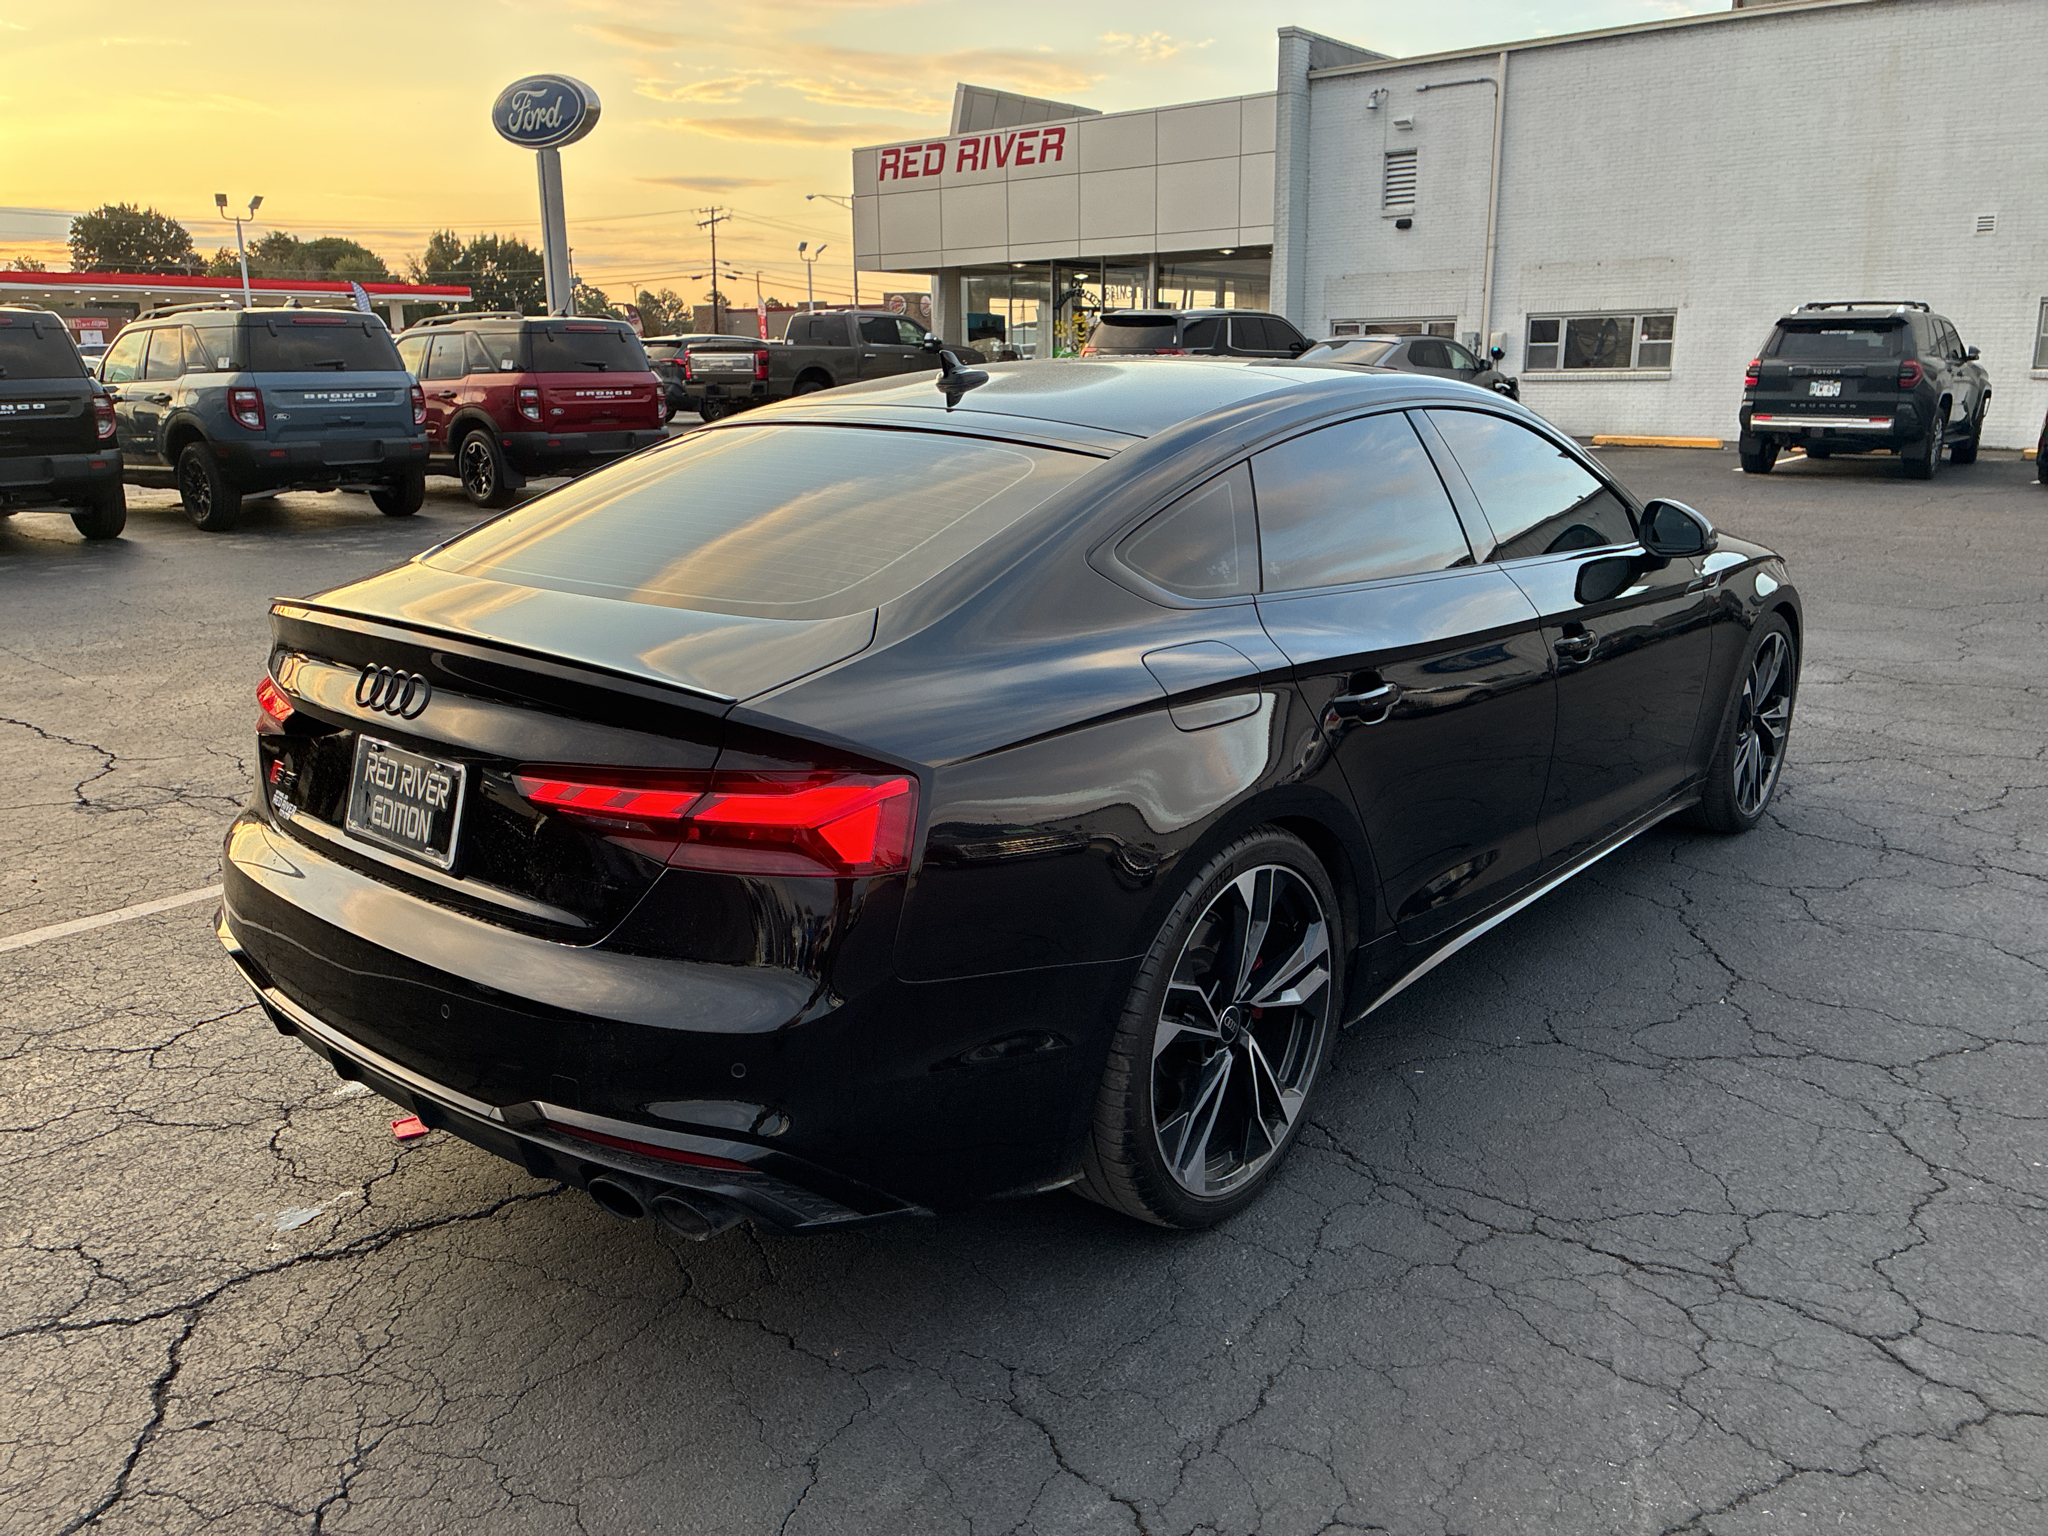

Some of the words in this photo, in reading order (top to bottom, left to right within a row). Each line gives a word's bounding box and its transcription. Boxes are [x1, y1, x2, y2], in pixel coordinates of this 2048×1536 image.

[507, 89, 563, 134] Ford
[879, 143, 947, 182] RED
[955, 127, 1066, 174] RIVER
[364, 752, 398, 791] RED
[398, 763, 451, 810] RIVER
[280, 799, 298, 816] RIVER
[371, 795, 432, 845] EDITION
